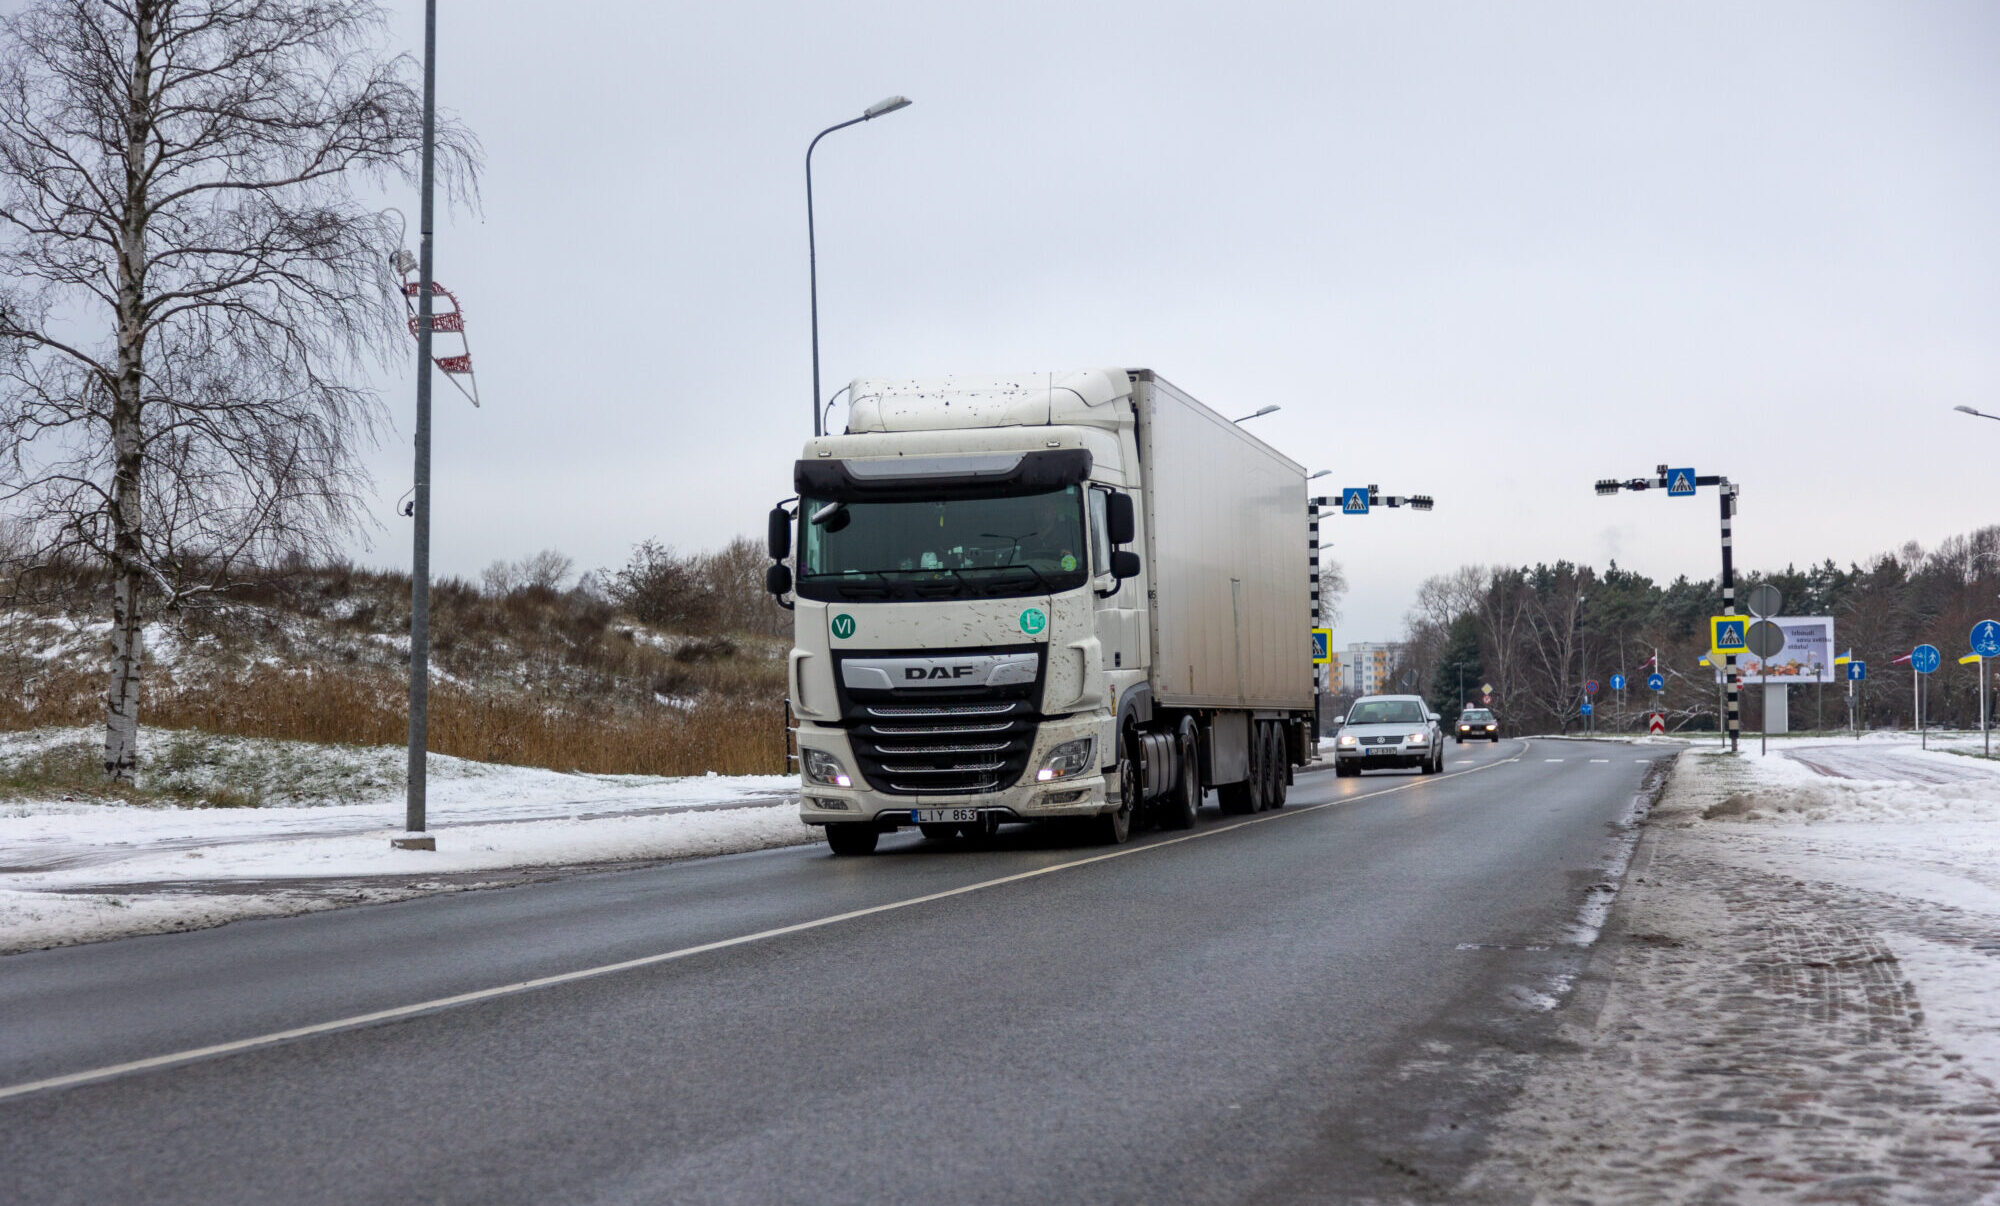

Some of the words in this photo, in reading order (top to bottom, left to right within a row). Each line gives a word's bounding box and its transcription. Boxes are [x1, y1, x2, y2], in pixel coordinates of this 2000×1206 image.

[835, 618, 851, 634] VI
[1026, 613, 1039, 630] L
[905, 665, 973, 680] DAF
[919, 810, 944, 821] LIY
[953, 809, 975, 820] 863
